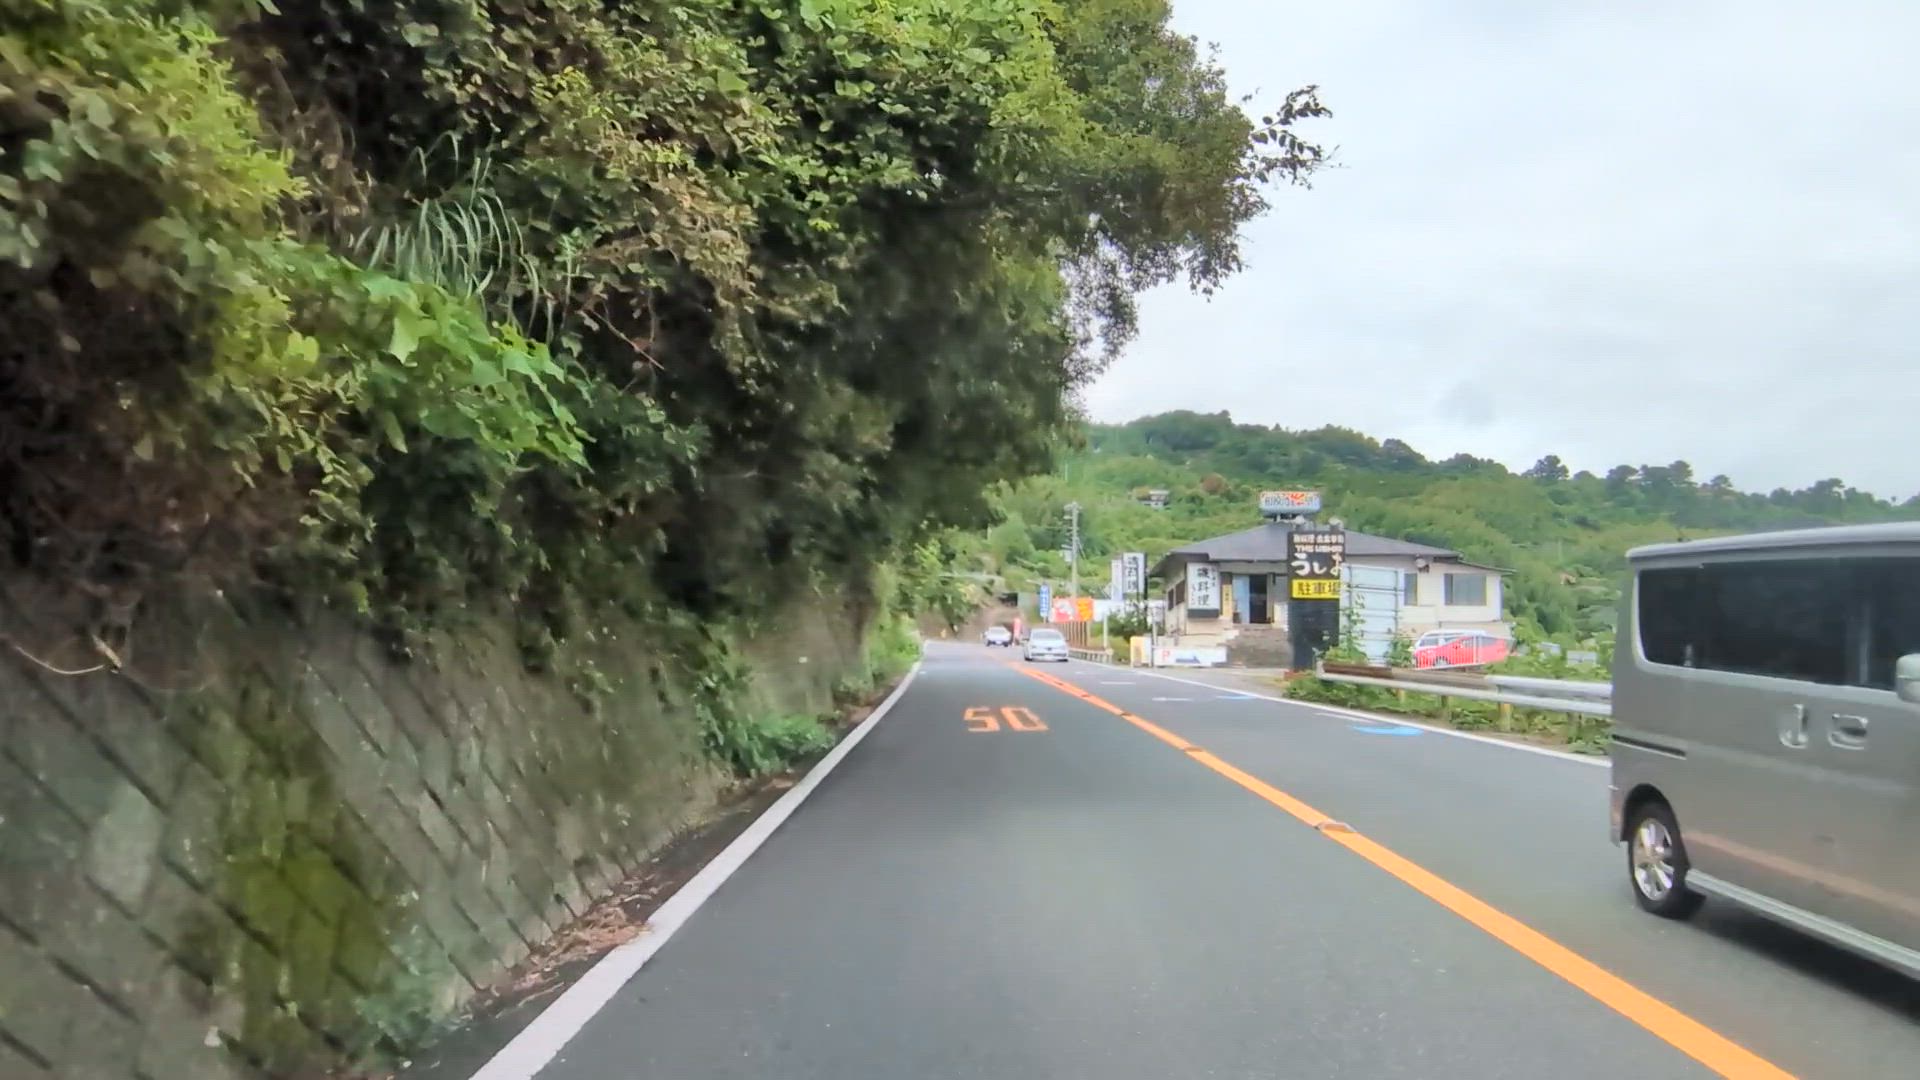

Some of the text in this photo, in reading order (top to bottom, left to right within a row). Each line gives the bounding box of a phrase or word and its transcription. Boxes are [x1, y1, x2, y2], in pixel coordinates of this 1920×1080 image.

[1290, 552, 1342, 576] うしお
[963, 706, 1050, 732] 50
